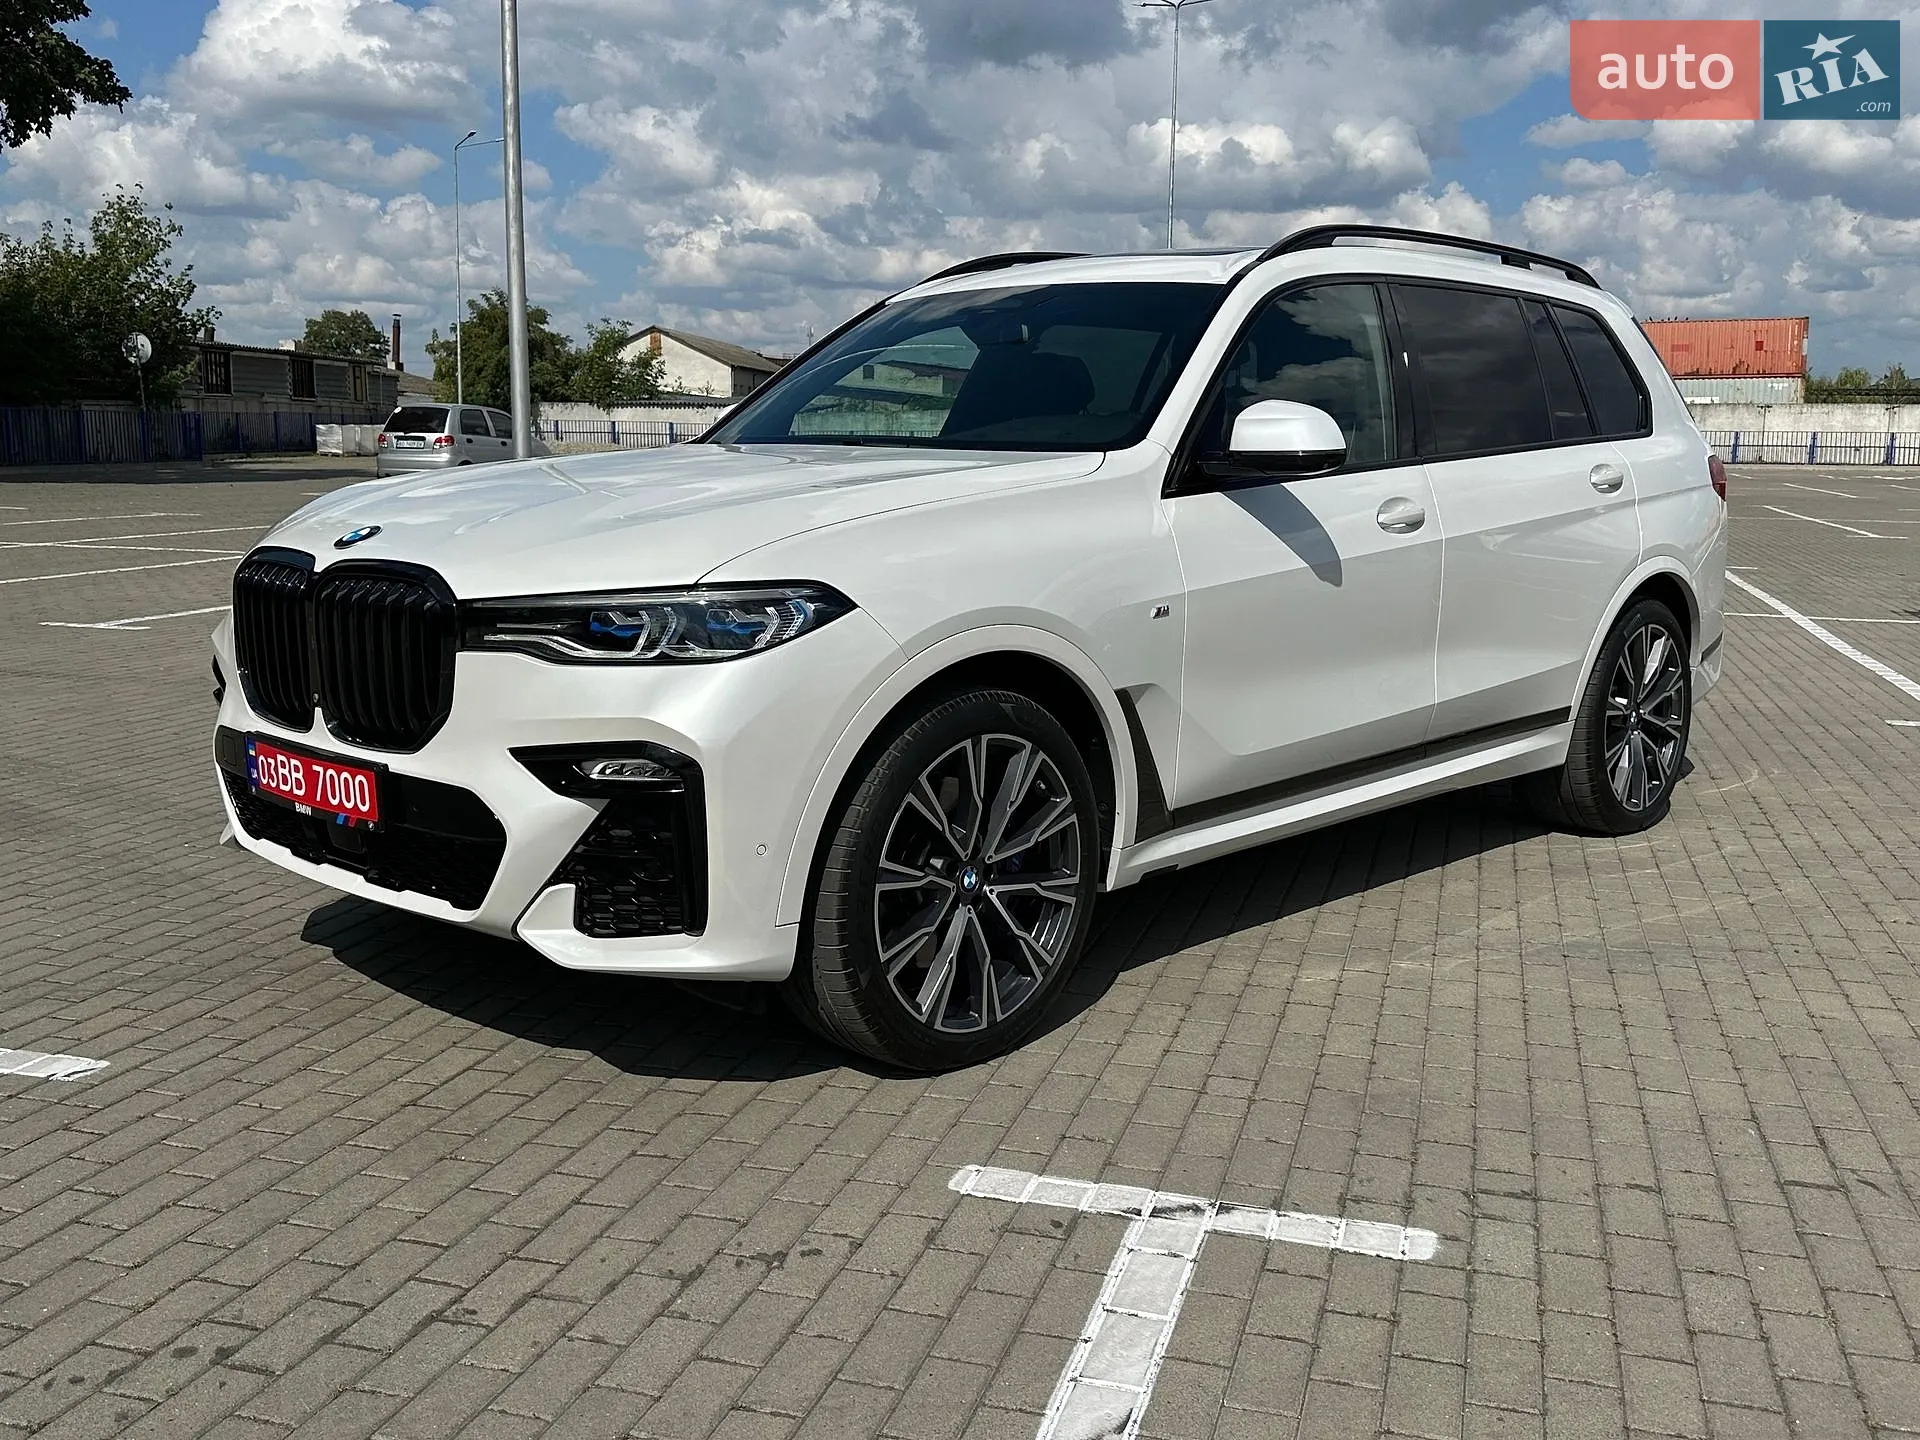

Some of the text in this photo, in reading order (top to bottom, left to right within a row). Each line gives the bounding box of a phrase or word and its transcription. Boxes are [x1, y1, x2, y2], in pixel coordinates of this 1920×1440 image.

[259, 754, 370, 812] 03BB 7000
[295, 802, 311, 816] BMW
